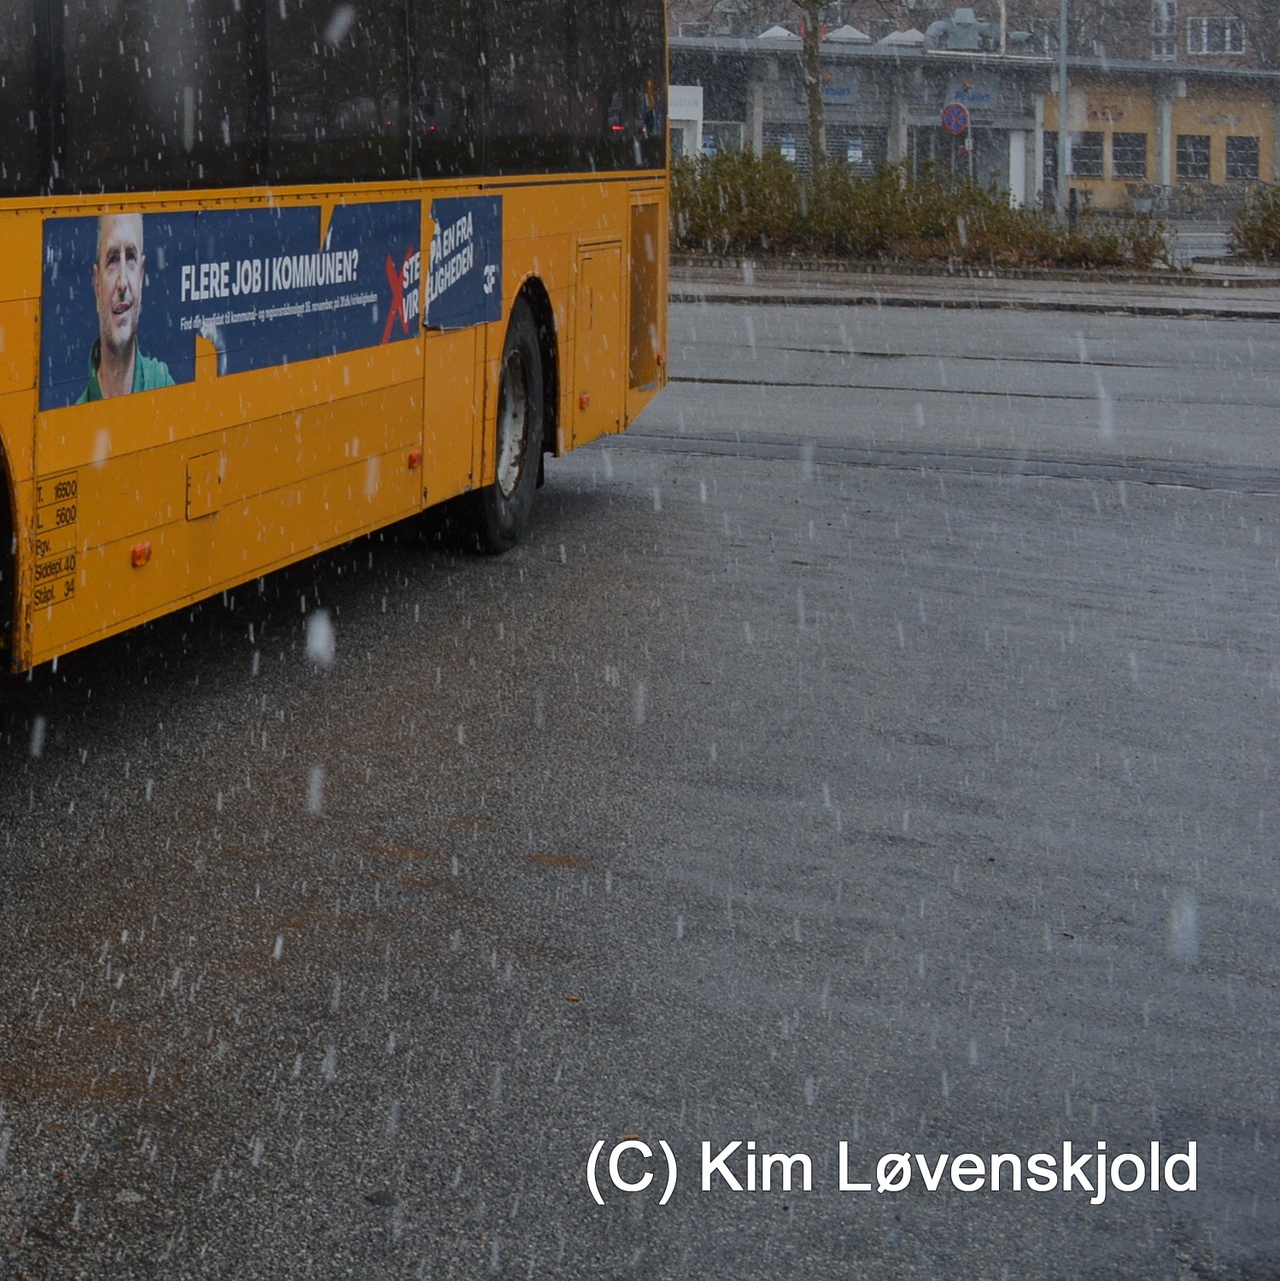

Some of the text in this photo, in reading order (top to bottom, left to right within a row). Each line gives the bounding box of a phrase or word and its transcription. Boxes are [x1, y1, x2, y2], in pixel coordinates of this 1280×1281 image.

[443, 224, 455, 258] EN
[456, 211, 473, 247] FRA
[181, 249, 359, 302] FLERE JOB I KOMMUNEN?
[483, 264, 495, 294] 3F
[54, 480, 78, 500] 16500
[56, 505, 77, 525] 5600
[64, 555, 76, 572] 40
[64, 578, 75, 597] 34
